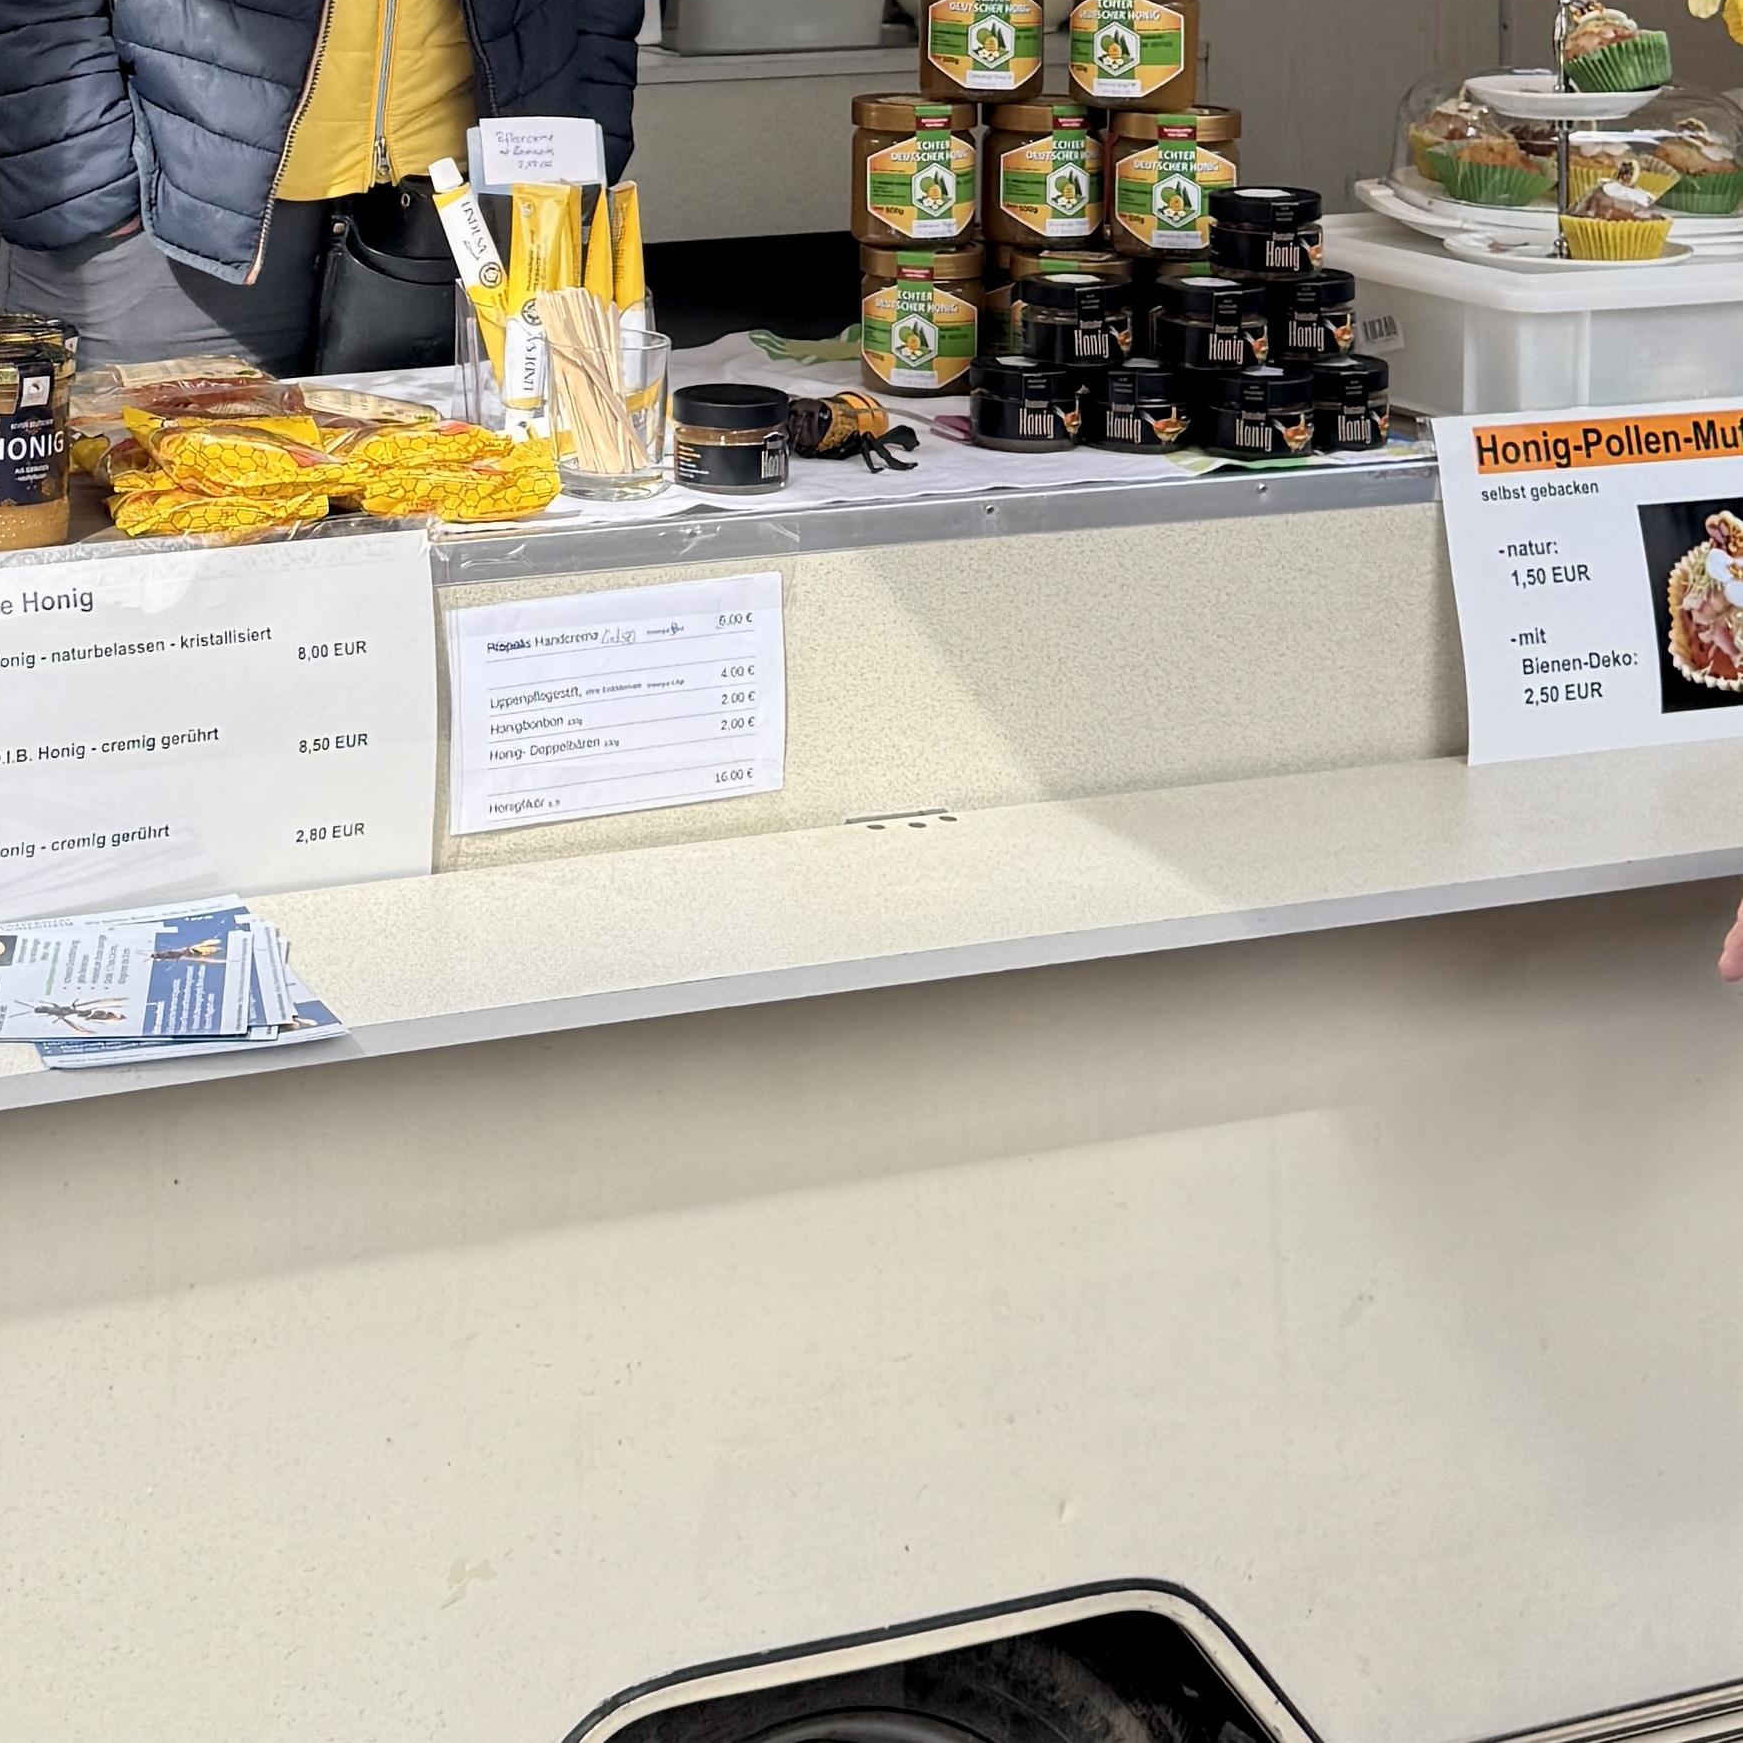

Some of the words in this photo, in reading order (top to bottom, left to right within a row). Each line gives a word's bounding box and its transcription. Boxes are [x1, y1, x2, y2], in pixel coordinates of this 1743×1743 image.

[1480, 485, 1527, 502] selbst
[1529, 480, 1600, 502] gebacken
[1510, 567, 1547, 590] 1,50
[1551, 563, 1592, 584] EUR
[22, 587, 94, 614] Honig
[51, 640, 166, 664] naturbelassen
[180, 626, 273, 650] kristallisiert
[297, 643, 329, 662] 8,00
[333, 640, 368, 657] EUR
[1521, 649, 1639, 676] Bienen-Deko:
[1523, 685, 1560, 707] 2,50
[1564, 681, 1604, 701] EUR
[38, 742, 86, 761] Honig
[100, 734, 156, 754] cremig
[160, 727, 220, 750] gerührt
[298, 736, 331, 755] 8,50
[335, 732, 369, 750] EUR
[50, 832, 107, 852] cremig
[111, 823, 170, 848] gerührt
[295, 826, 327, 845] 2,80
[331, 822, 365, 839] EUR
